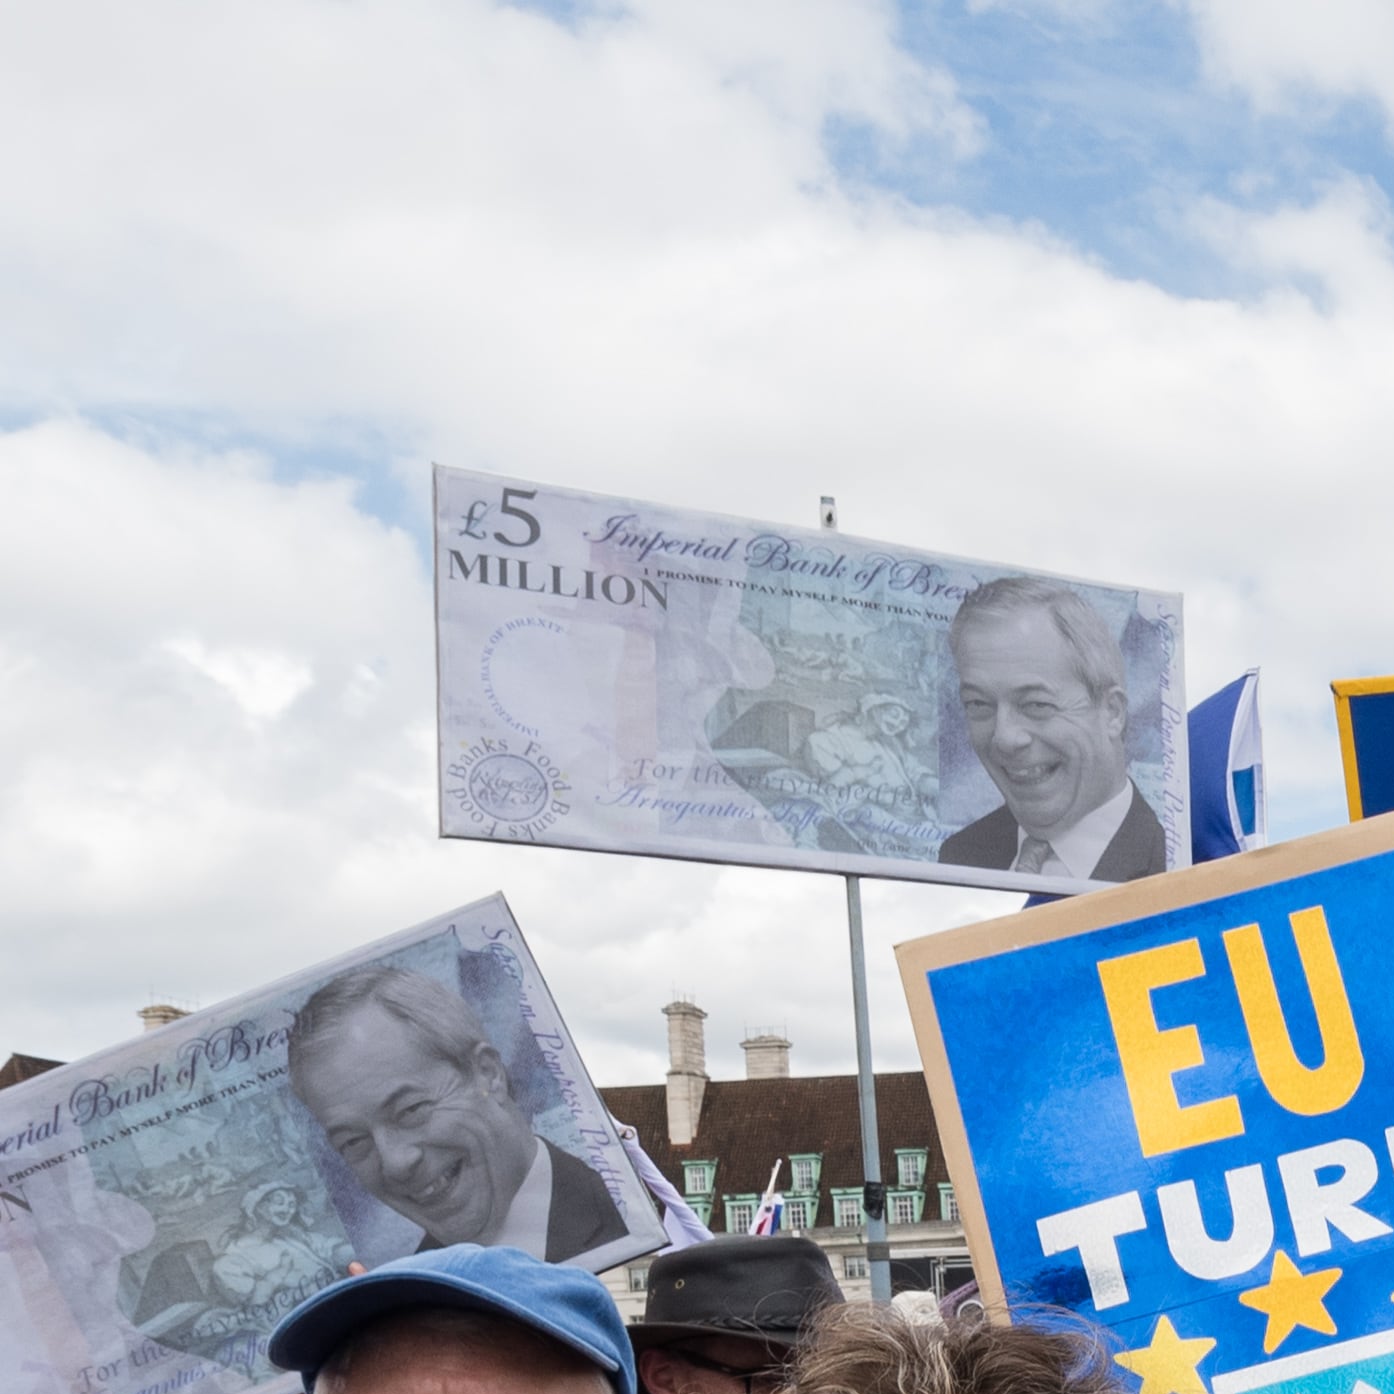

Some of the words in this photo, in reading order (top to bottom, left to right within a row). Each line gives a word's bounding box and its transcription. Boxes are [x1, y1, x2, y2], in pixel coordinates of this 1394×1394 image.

[458, 487, 541, 548] £5
[447, 548, 669, 611] MILLION
[582, 514, 740, 562] Imperial
[744, 534, 847, 579] Bank
[854, 551, 896, 594] of
[656, 569, 723, 587] PROMISE
[728, 578, 748, 590] TO
[751, 582, 778, 596] PAY
[780, 587, 836, 603] MYSELF
[841, 596, 882, 612] MORE
[886, 604, 922, 617] THAN
[925, 611, 953, 623] YOU
[505, 616, 565, 634] BREXIT
[447, 736, 508, 781] Banks
[524, 740, 572, 792] Food
[692, 762, 735, 786] the
[508, 799, 571, 840] Banks
[594, 784, 756, 825] Arrogantus
[1097, 904, 1366, 1159] EU
[0, 1104, 63, 1156] erial
[69, 1063, 168, 1127] Bank
[176, 1037, 210, 1098] of
[7, 1153, 67, 1184] PROMISE
[69, 1145, 90, 1159] TO
[90, 1133, 118, 1150] PAY
[120, 1112, 174, 1138] MYSELF
[175, 1094, 218, 1118] MORE
[220, 1079, 257, 1099] THAN
[257, 1064, 290, 1083] YOU
[75, 1355, 122, 1394] For
[131, 1341, 177, 1368] the
